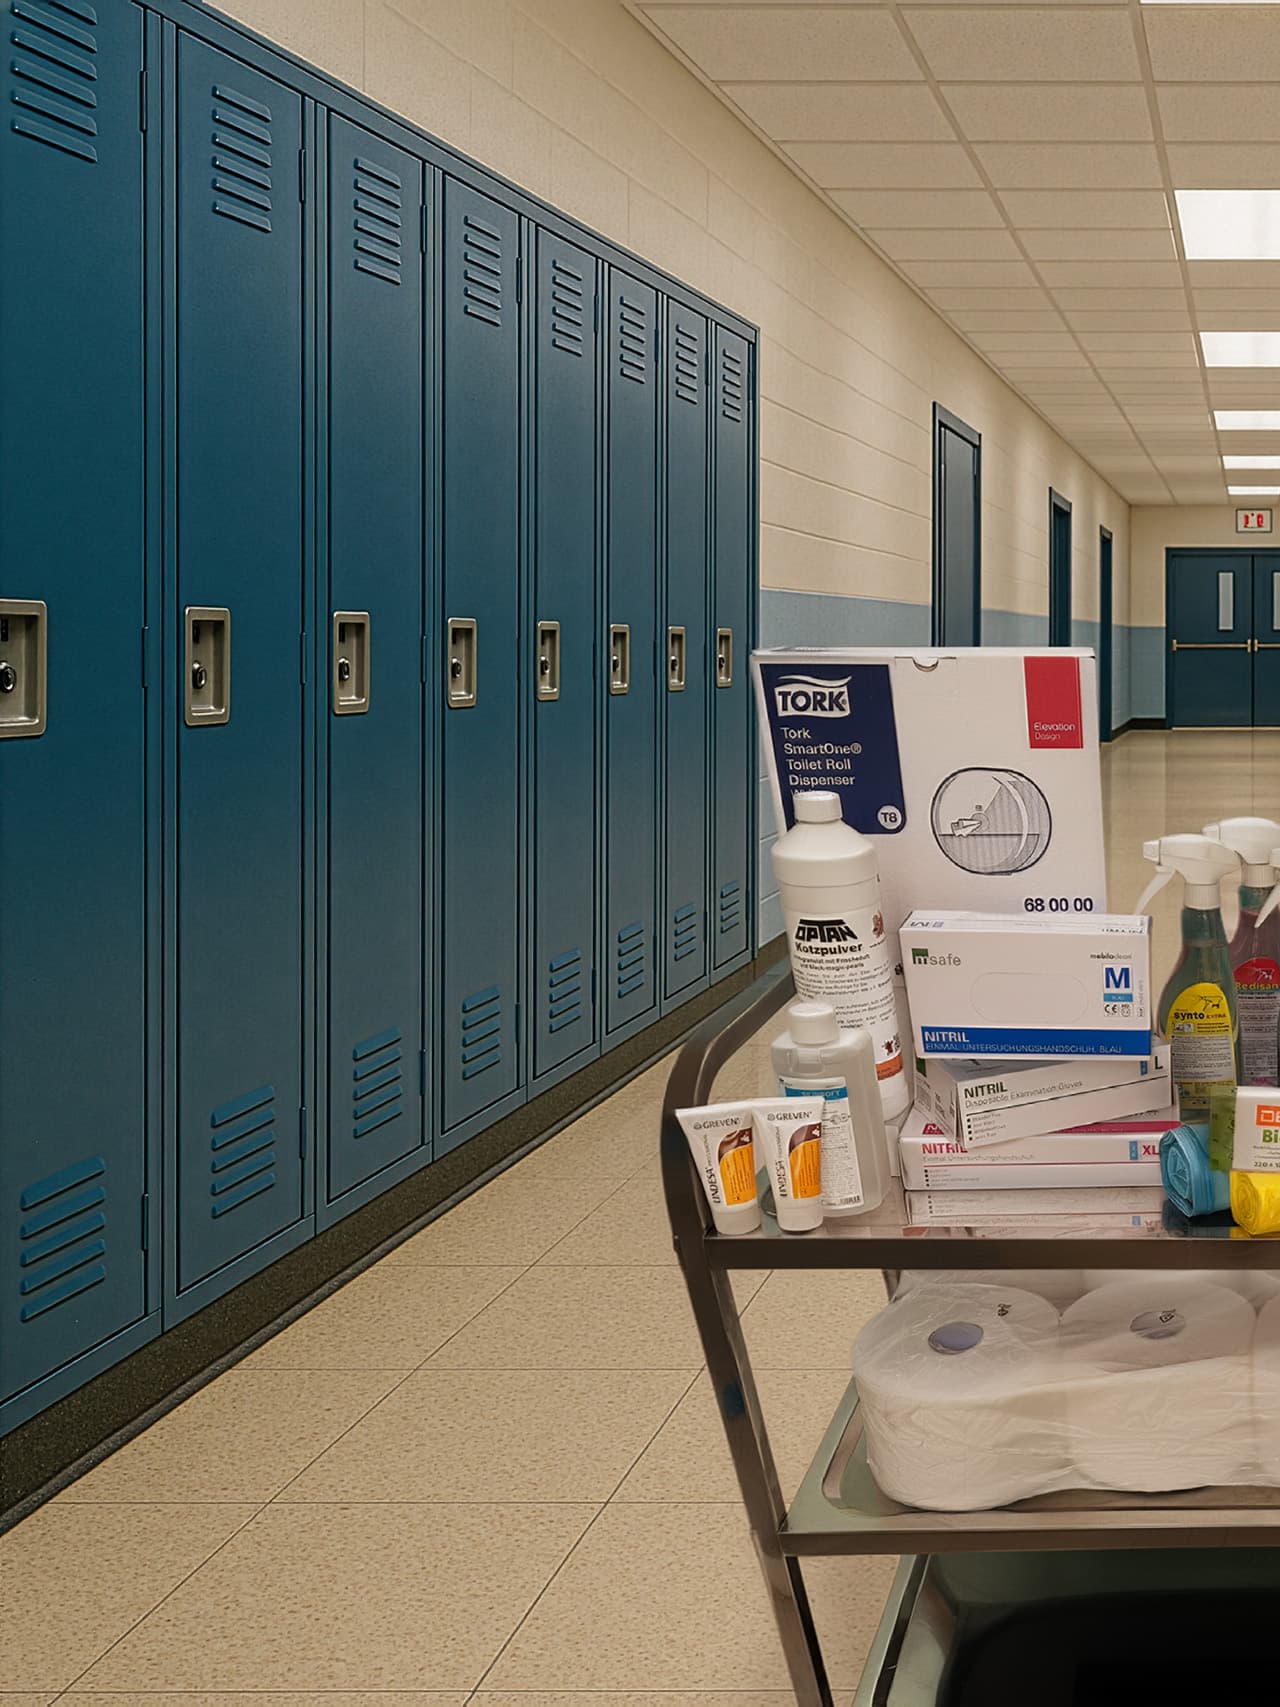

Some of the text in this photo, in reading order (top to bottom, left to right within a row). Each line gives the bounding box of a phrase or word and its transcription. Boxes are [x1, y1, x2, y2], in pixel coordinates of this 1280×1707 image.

[777, 690, 846, 712] TORK
[780, 727, 811, 739] Tork
[1033, 722, 1076, 732] Elevation
[786, 758, 852, 771] Toilet Roll
[788, 774, 856, 787] Dispenser
[881, 812, 898, 823] T8
[1024, 897, 1094, 913] 68 00 00
[794, 942, 863, 957] Kotzpulver
[1104, 967, 1130, 989] M
[1174, 1011, 1205, 1021] synto
[925, 1031, 970, 1043] NITRIL
[1099, 1044, 1122, 1053] BLAU
[1154, 1056, 1164, 1070] L
[964, 1081, 1008, 1099] NITRIL
[1010, 1086, 1056, 1099] Examination
[1058, 1080, 1083, 1092] Gloves
[922, 1142, 968, 1155] NITRIL
[1142, 1144, 1160, 1156] XL
[706, 1168, 721, 1204] LINDESA
